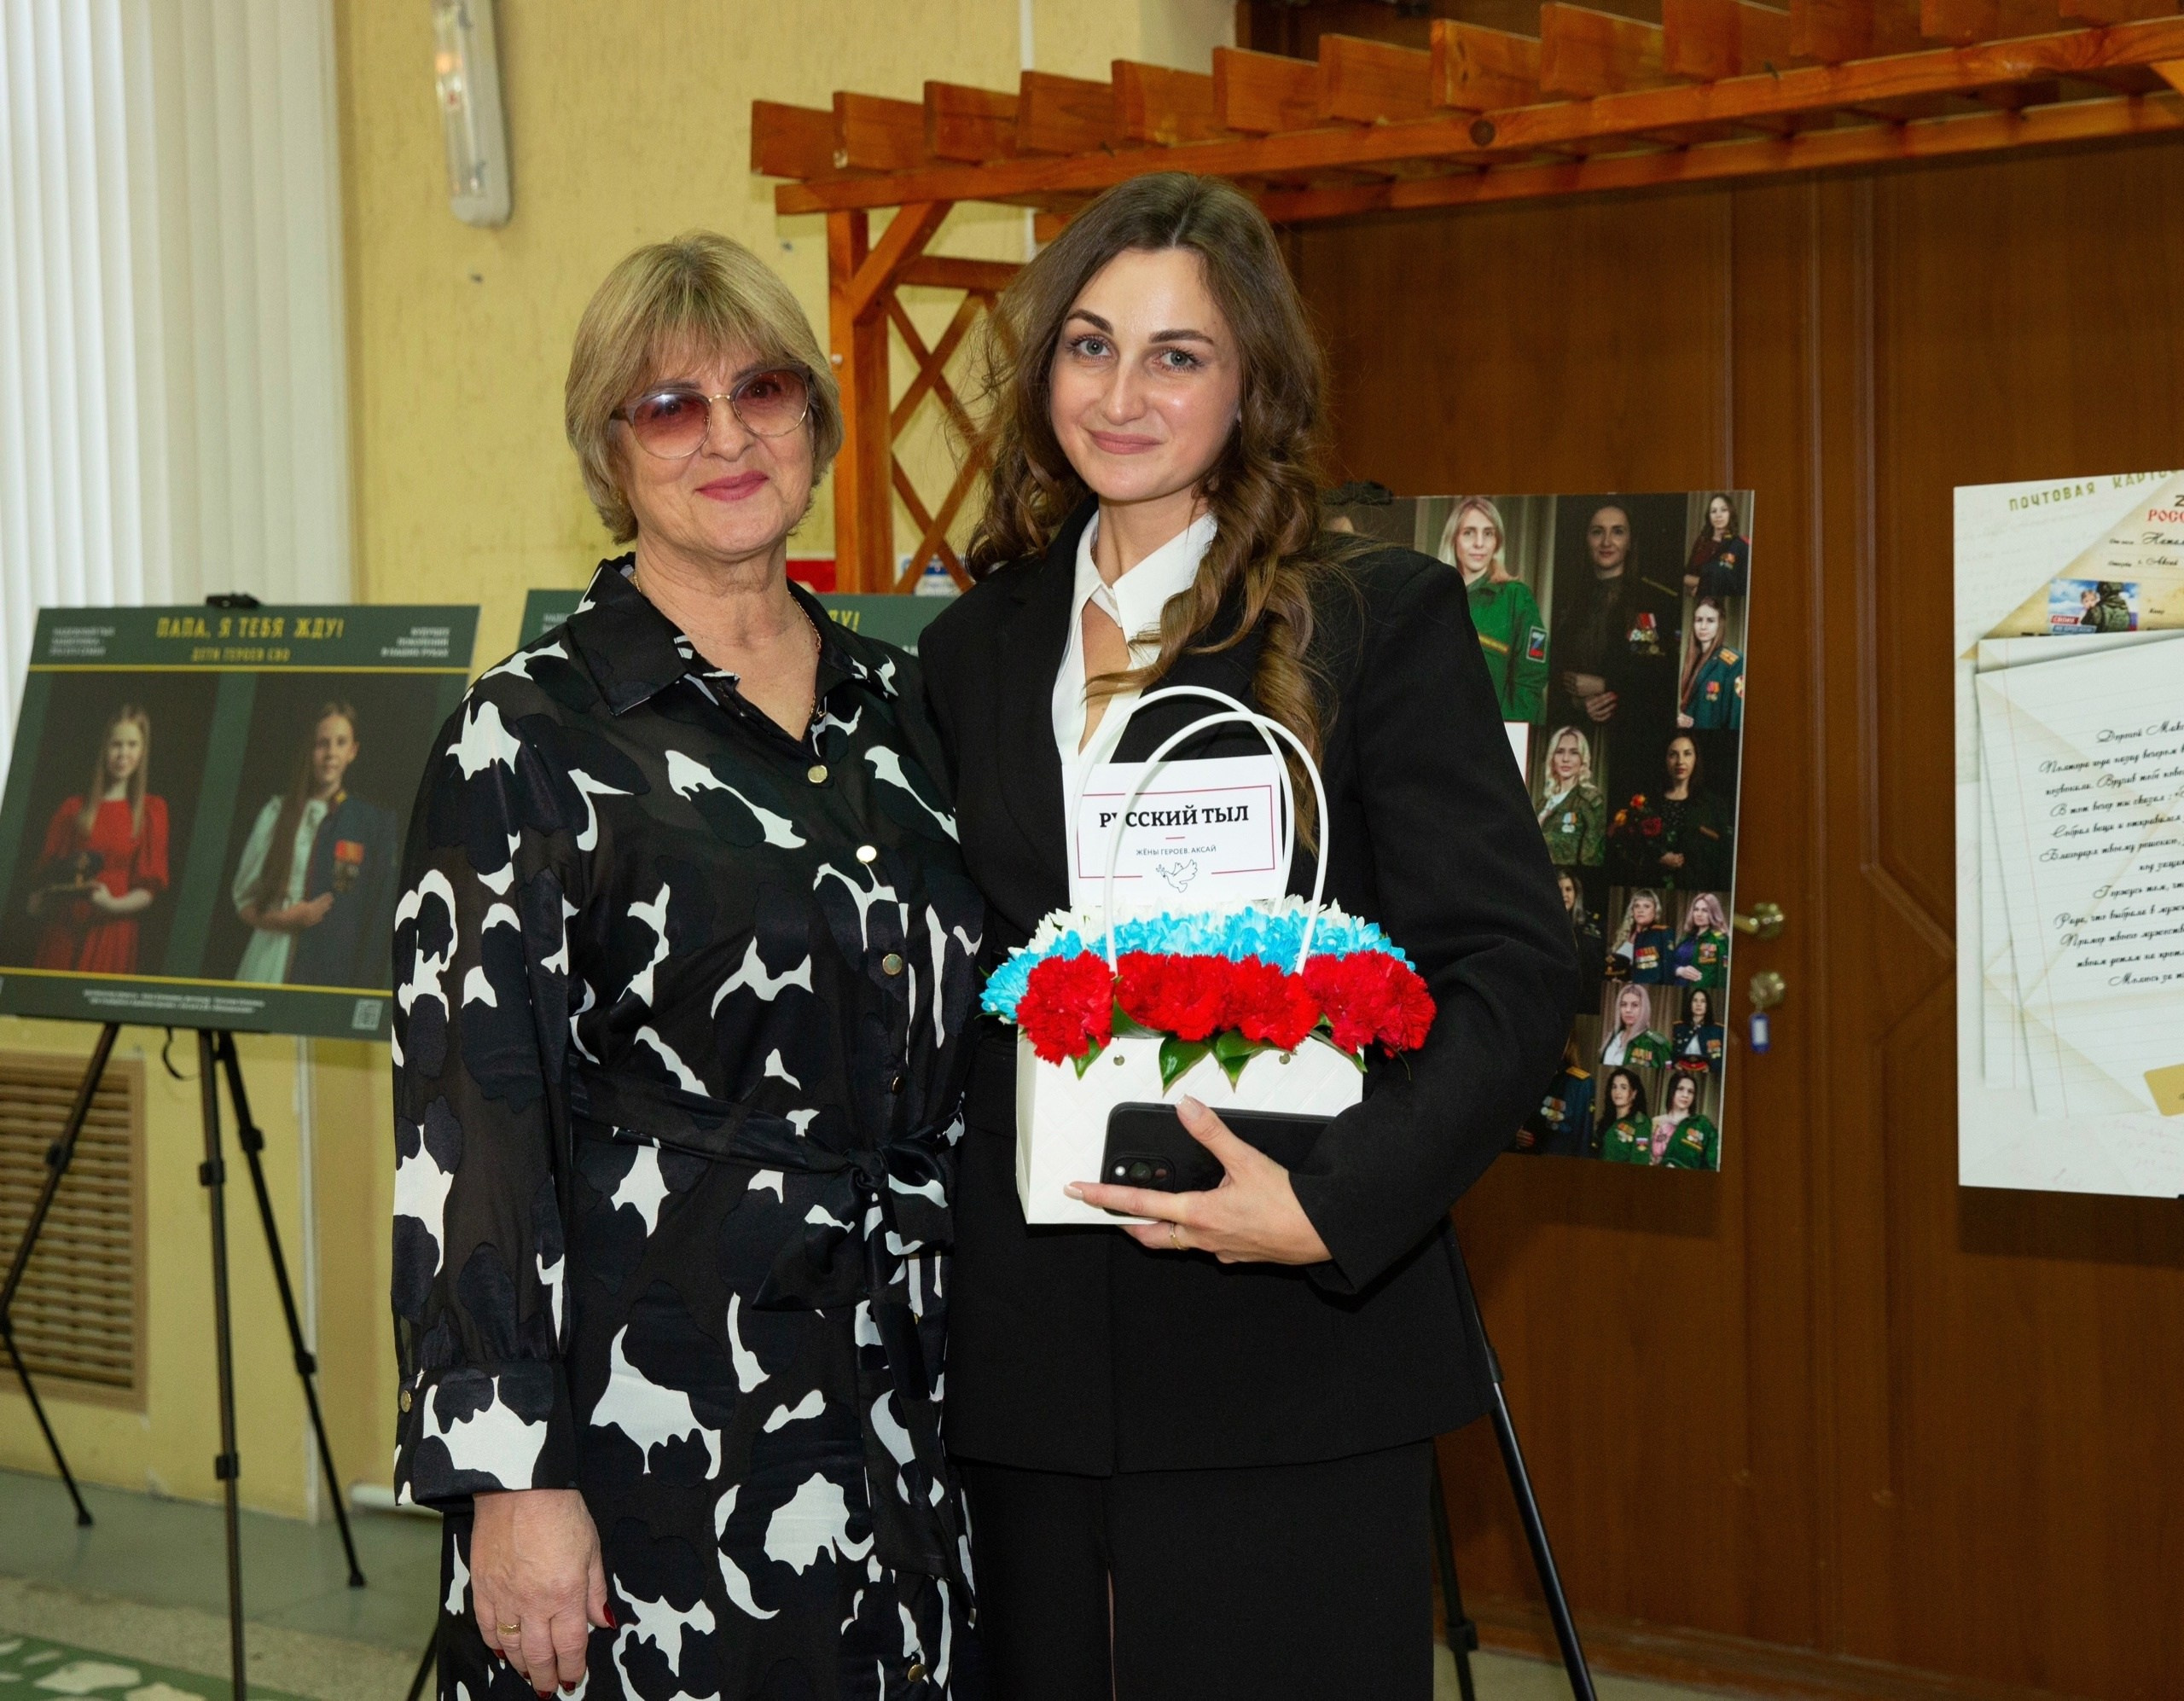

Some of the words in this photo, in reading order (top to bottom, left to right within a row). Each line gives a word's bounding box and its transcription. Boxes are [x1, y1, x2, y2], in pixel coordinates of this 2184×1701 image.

[2009, 481, 2096, 512] ПОЧТОВАЯ
[156, 616, 212, 639] ПАПА,
[218, 616, 233, 638] Я
[238, 616, 286, 639] ТЕБЯ
[293, 617, 345, 640] ЖДУ!
[1099, 804, 1198, 827] РССКИЙ
[1202, 805, 1249, 824] ТЫЛ
[1136, 848, 1159, 856] ЖЁНЫ
[1160, 847, 1190, 856] ГЕРОЕВ.
[1191, 845, 1217, 854] АКСАЙ
